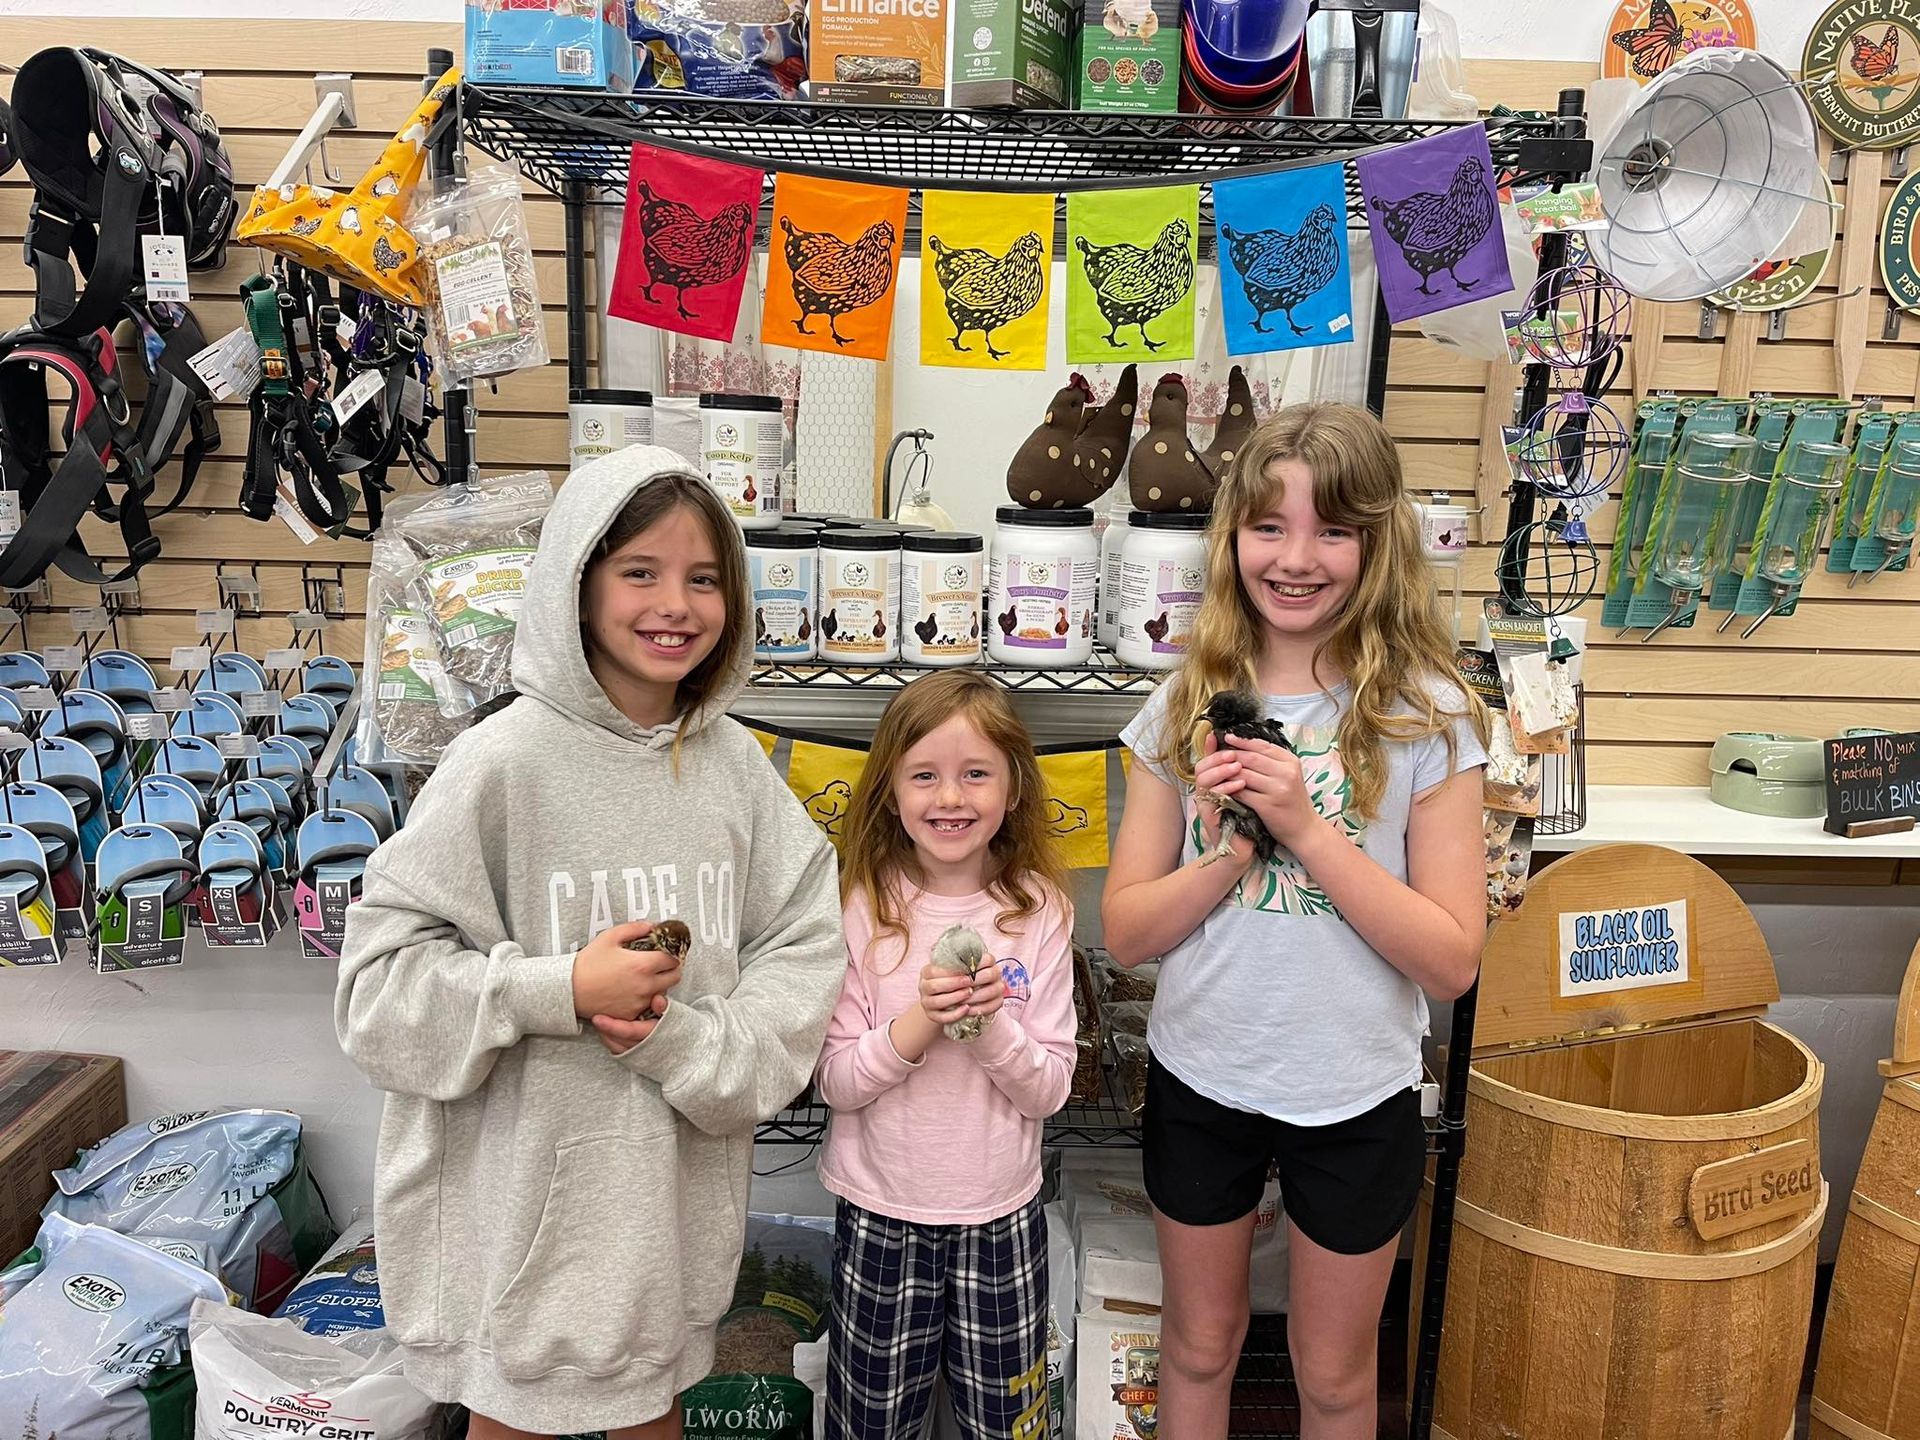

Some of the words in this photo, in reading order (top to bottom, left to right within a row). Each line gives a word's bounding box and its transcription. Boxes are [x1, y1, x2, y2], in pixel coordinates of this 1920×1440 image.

[1022, 0, 1067, 37] Defend
[1815, 0, 1882, 62] NATIVE
[890, 92, 928, 100] FUNCTIONAL
[1820, 85, 1862, 131] BENEFIT
[1534, 197, 1573, 205] hanging
[1891, 205, 1909, 245] BIRD
[1905, 195, 1916, 205] &
[596, 446, 613, 456] Kel
[705, 451, 726, 459] Coop
[729, 452, 752, 463] Kelp
[444, 561, 474, 577] EXOTIC
[476, 568, 522, 583] DRIED
[832, 590, 860, 599] Brewer's
[861, 590, 879, 599] Yeast
[931, 593, 960, 602] Brewer's
[1488, 620, 1513, 630] CHICKEN
[1513, 621, 1541, 632] BANQUET
[1832, 740, 1866, 763] Please
[1874, 737, 1893, 762] NO
[1832, 767, 1840, 786] &
[1841, 763, 1883, 788] matching
[1889, 757, 1900, 775] of
[1840, 788, 1884, 813] BULK
[1889, 780, 1920, 811] BINS
[214, 889, 232, 898] XS
[325, 886, 342, 898] M
[139, 900, 152, 912] S
[1576, 911, 1639, 949] BLACK
[1642, 908, 1674, 940] OIL
[124, 942, 163, 950] adventure
[141, 957, 165, 965] alcott
[1569, 940, 1679, 983] SUNFLOWER
[134, 1165, 188, 1191] EXOTIC
[221, 1188, 241, 1204] 11
[1704, 1173, 1753, 1223] Bird
[1761, 1159, 1812, 1205] Seed
[69, 1276, 123, 1302] EXOTIC
[73, 1286, 113, 1308] NUTRITION
[131, 1349, 165, 1364] LB
[1120, 1391, 1145, 1401] CHEF
[270, 1396, 327, 1418] VERMONT
[224, 1400, 316, 1436] POULTRY
[319, 1426, 375, 1440] GRIT
[684, 1408, 793, 1430] LWORM
